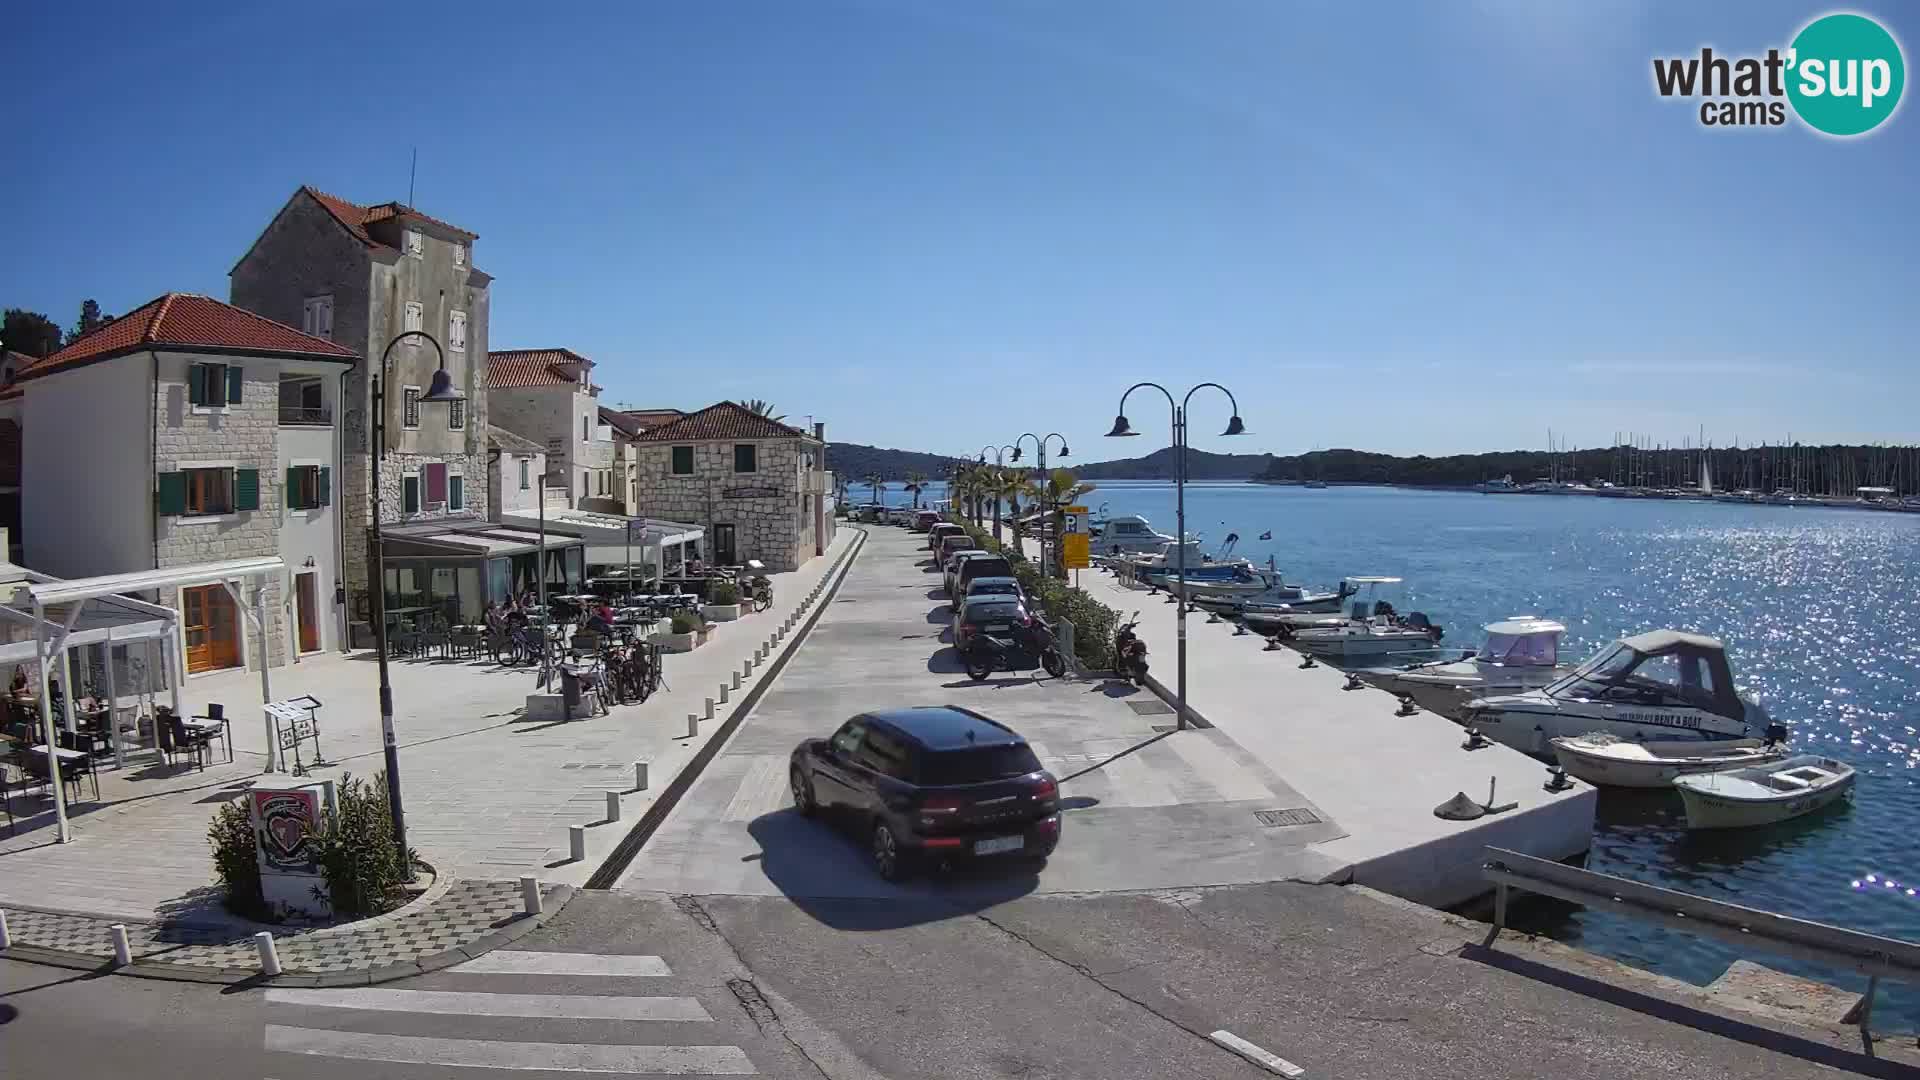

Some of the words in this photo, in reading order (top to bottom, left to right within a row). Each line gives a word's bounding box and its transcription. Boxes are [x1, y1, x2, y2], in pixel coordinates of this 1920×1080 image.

[1065, 515, 1076, 532] P
[1654, 714, 1674, 726] RENT
[1682, 716, 1702, 729] BOAT
